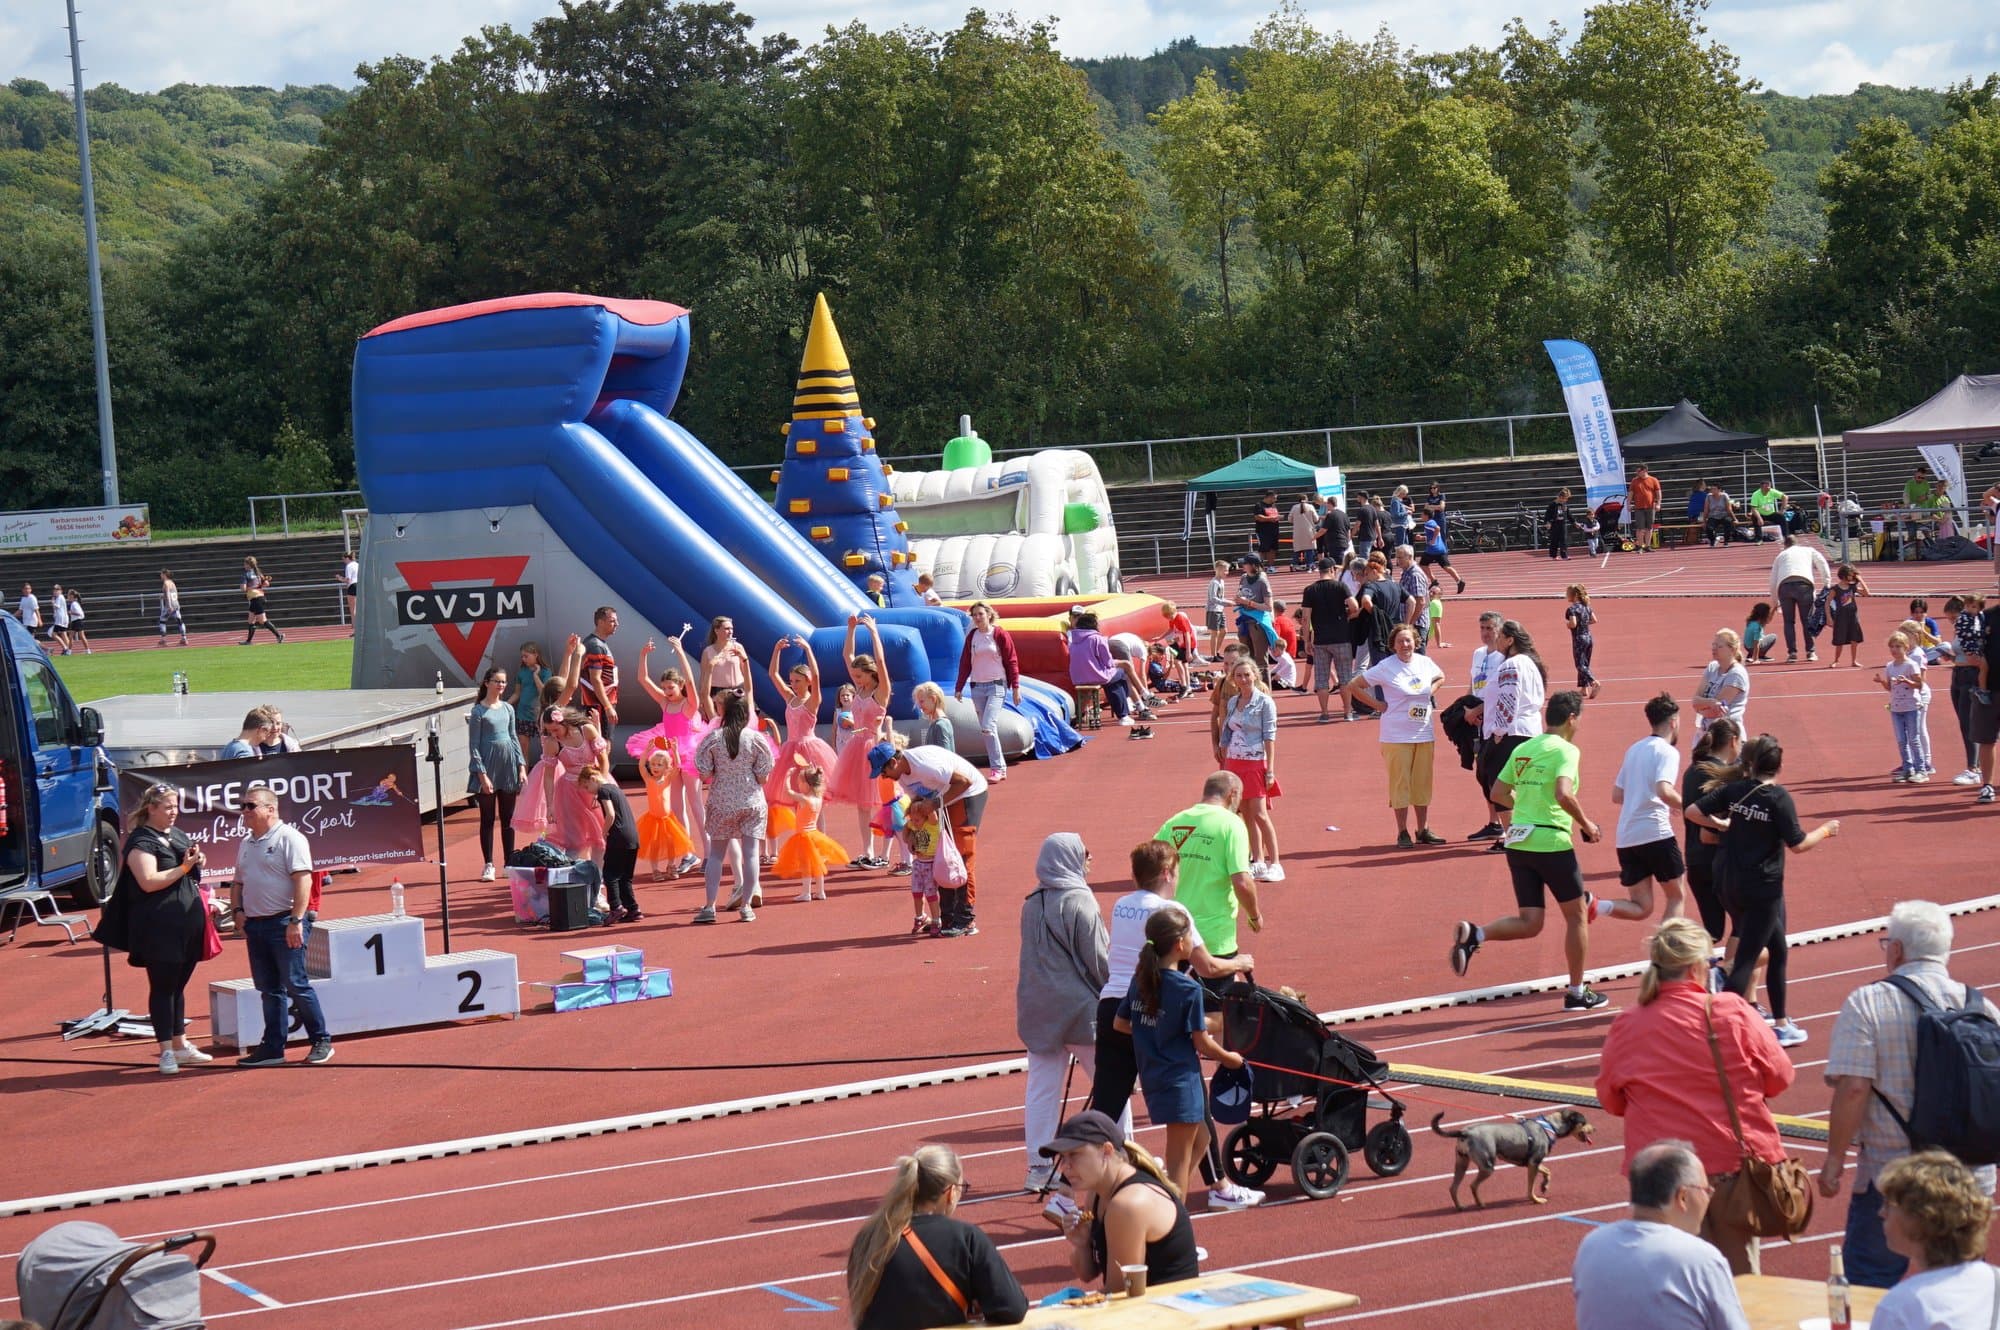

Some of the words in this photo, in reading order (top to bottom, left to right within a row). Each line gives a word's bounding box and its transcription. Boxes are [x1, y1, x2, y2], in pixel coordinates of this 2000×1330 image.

[0, 532, 28, 543] arkt
[406, 590, 524, 621] CVJM
[178, 781, 242, 814] LIFE
[302, 806, 357, 836] Sport
[364, 933, 385, 976] 1
[457, 970, 485, 1013] 2
